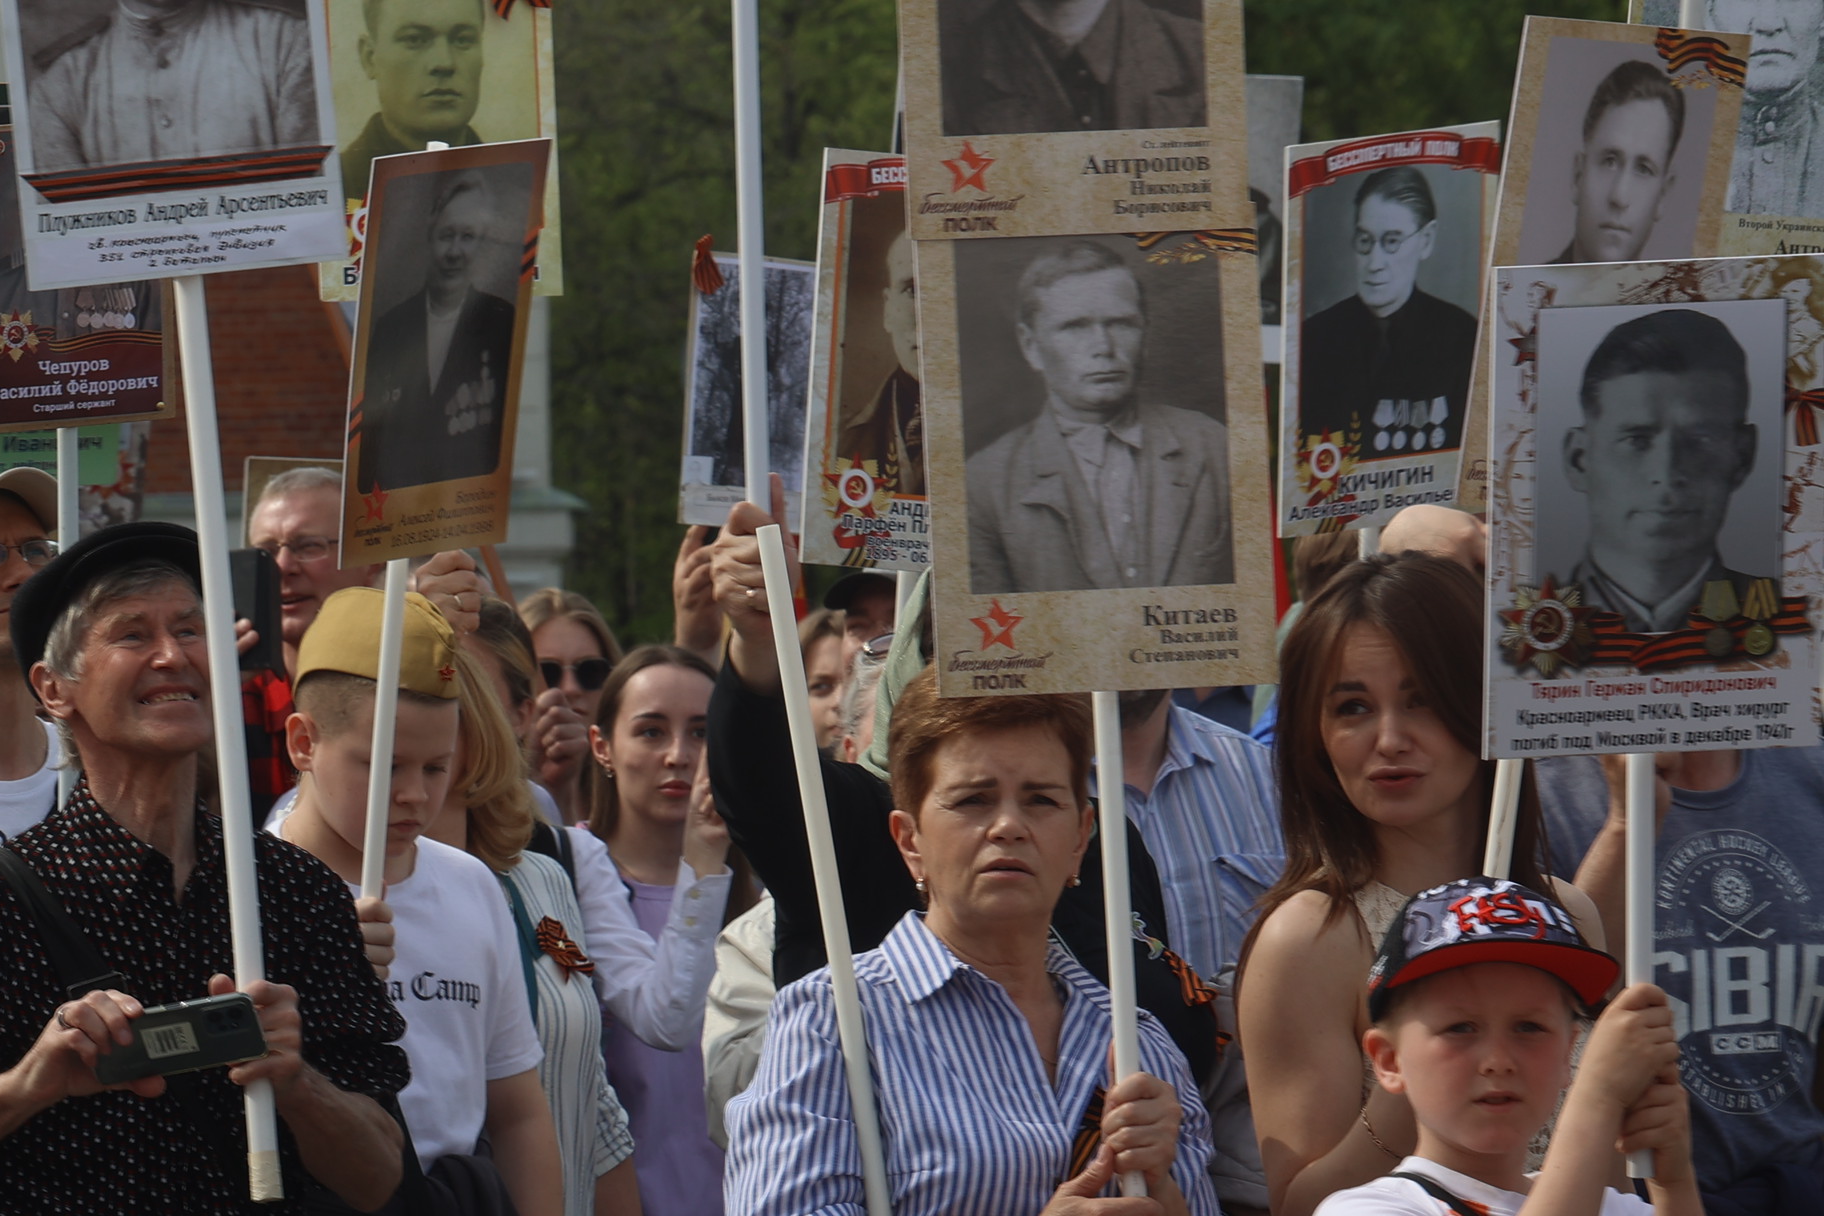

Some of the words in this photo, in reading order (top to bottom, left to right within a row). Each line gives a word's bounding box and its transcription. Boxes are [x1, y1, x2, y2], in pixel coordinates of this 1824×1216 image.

[1080, 155, 1211, 179] Антропов
[1130, 179, 1212, 195] Николай
[38, 209, 137, 236] Плужников
[144, 198, 208, 224] Андрей
[216, 189, 329, 218] Арсентьевич
[1114, 200, 1212, 218] Борисович
[944, 216, 999, 233] ПОЛК
[1738, 218, 1773, 231] Второй
[37, 359, 110, 377] Чепуров
[66, 375, 159, 395] Фёдорович
[33, 401, 76, 413] Старший
[77, 399, 116, 411] сержант
[1338, 465, 1435, 494] КИЧИГИН
[1288, 498, 1379, 522] Александр
[842, 513, 907, 534] Парфён
[1141, 605, 1238, 627] Китаев
[1160, 628, 1239, 644] Василий
[1129, 647, 1240, 665] Степанович
[973, 674, 1027, 691] ПОЛК
[1585, 680, 1647, 701] Герман
[1650, 677, 1777, 698] Спиридонович
[1516, 709, 1636, 729] Красноармеец
[1690, 701, 1732, 721] Врач
[1734, 702, 1791, 719] хирург
[1511, 733, 1559, 751] погиб
[1561, 735, 1592, 752] под
[1595, 728, 1667, 748] Москвой
[1683, 726, 1752, 746] декабре
[410, 971, 481, 1010] Camp
[1716, 1033, 1780, 1051] CCM
